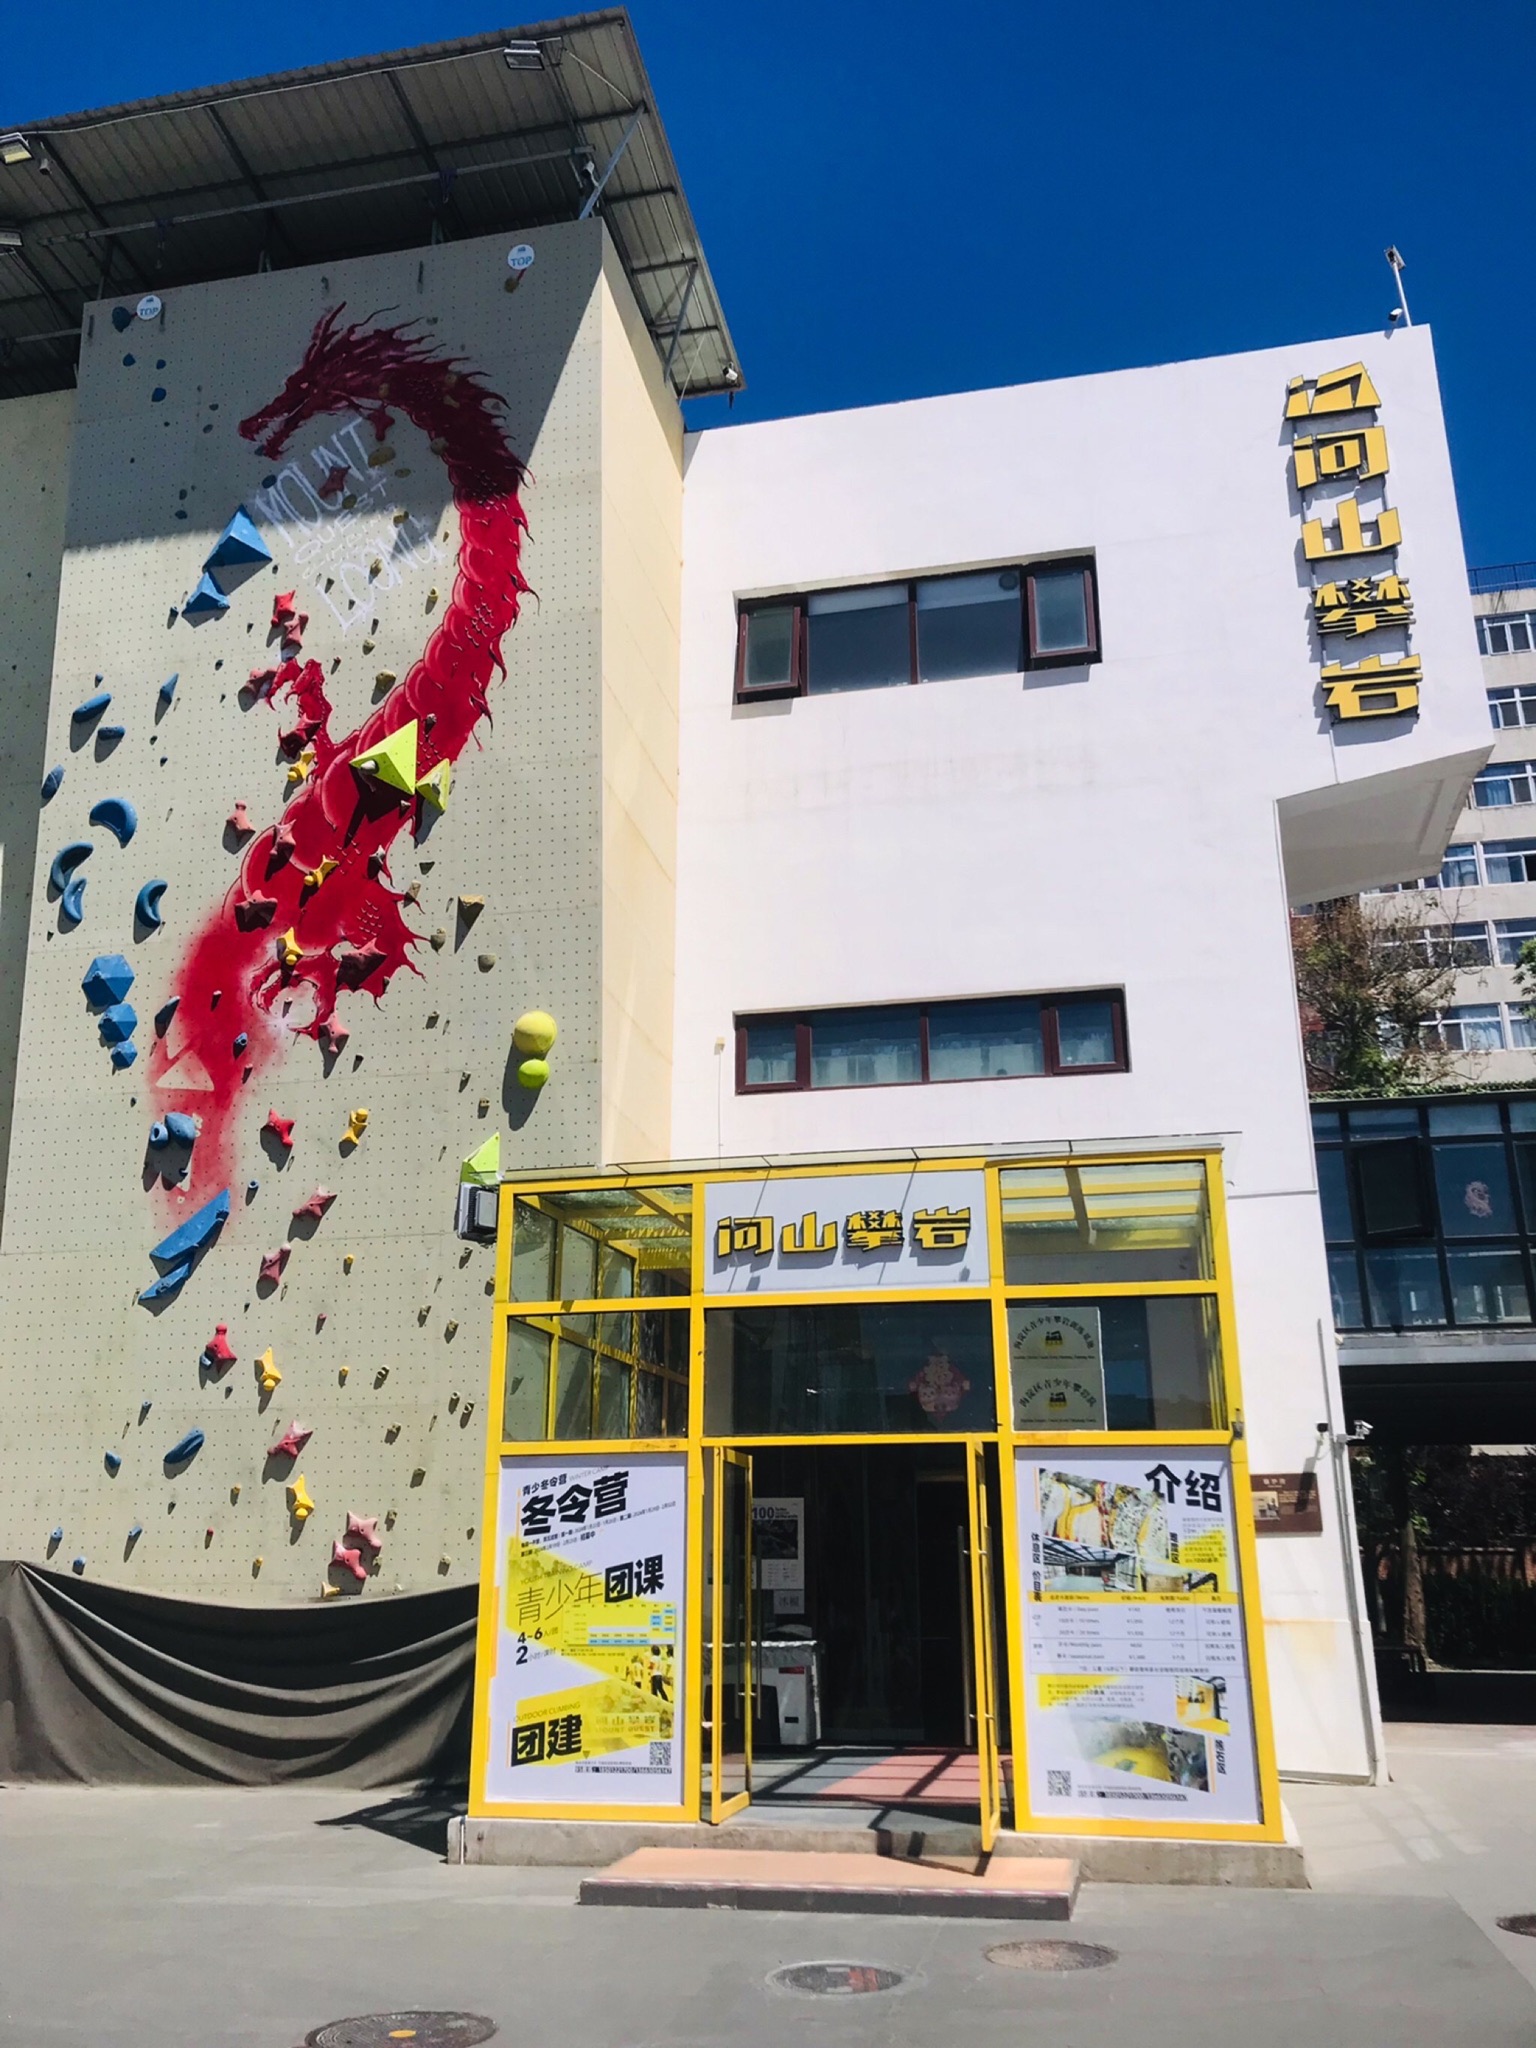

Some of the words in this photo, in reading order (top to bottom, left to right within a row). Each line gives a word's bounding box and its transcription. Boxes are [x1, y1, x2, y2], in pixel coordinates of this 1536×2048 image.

[510, 256, 533, 267] TOP
[140, 307, 159, 316] TOP
[254, 416, 370, 549] MOUNT
[294, 478, 387, 564] QUEST
[1293, 425, 1424, 719] 问山攀岩
[716, 1205, 972, 1257] 问山攀岩
[521, 1470, 630, 1537] 冬令营
[522, 1473, 567, 1496] 青少冬令营
[1144, 1463, 1223, 1513] 介绍
[515, 1554, 665, 1626] 青少年团课
[511, 1714, 583, 1767] 团建
